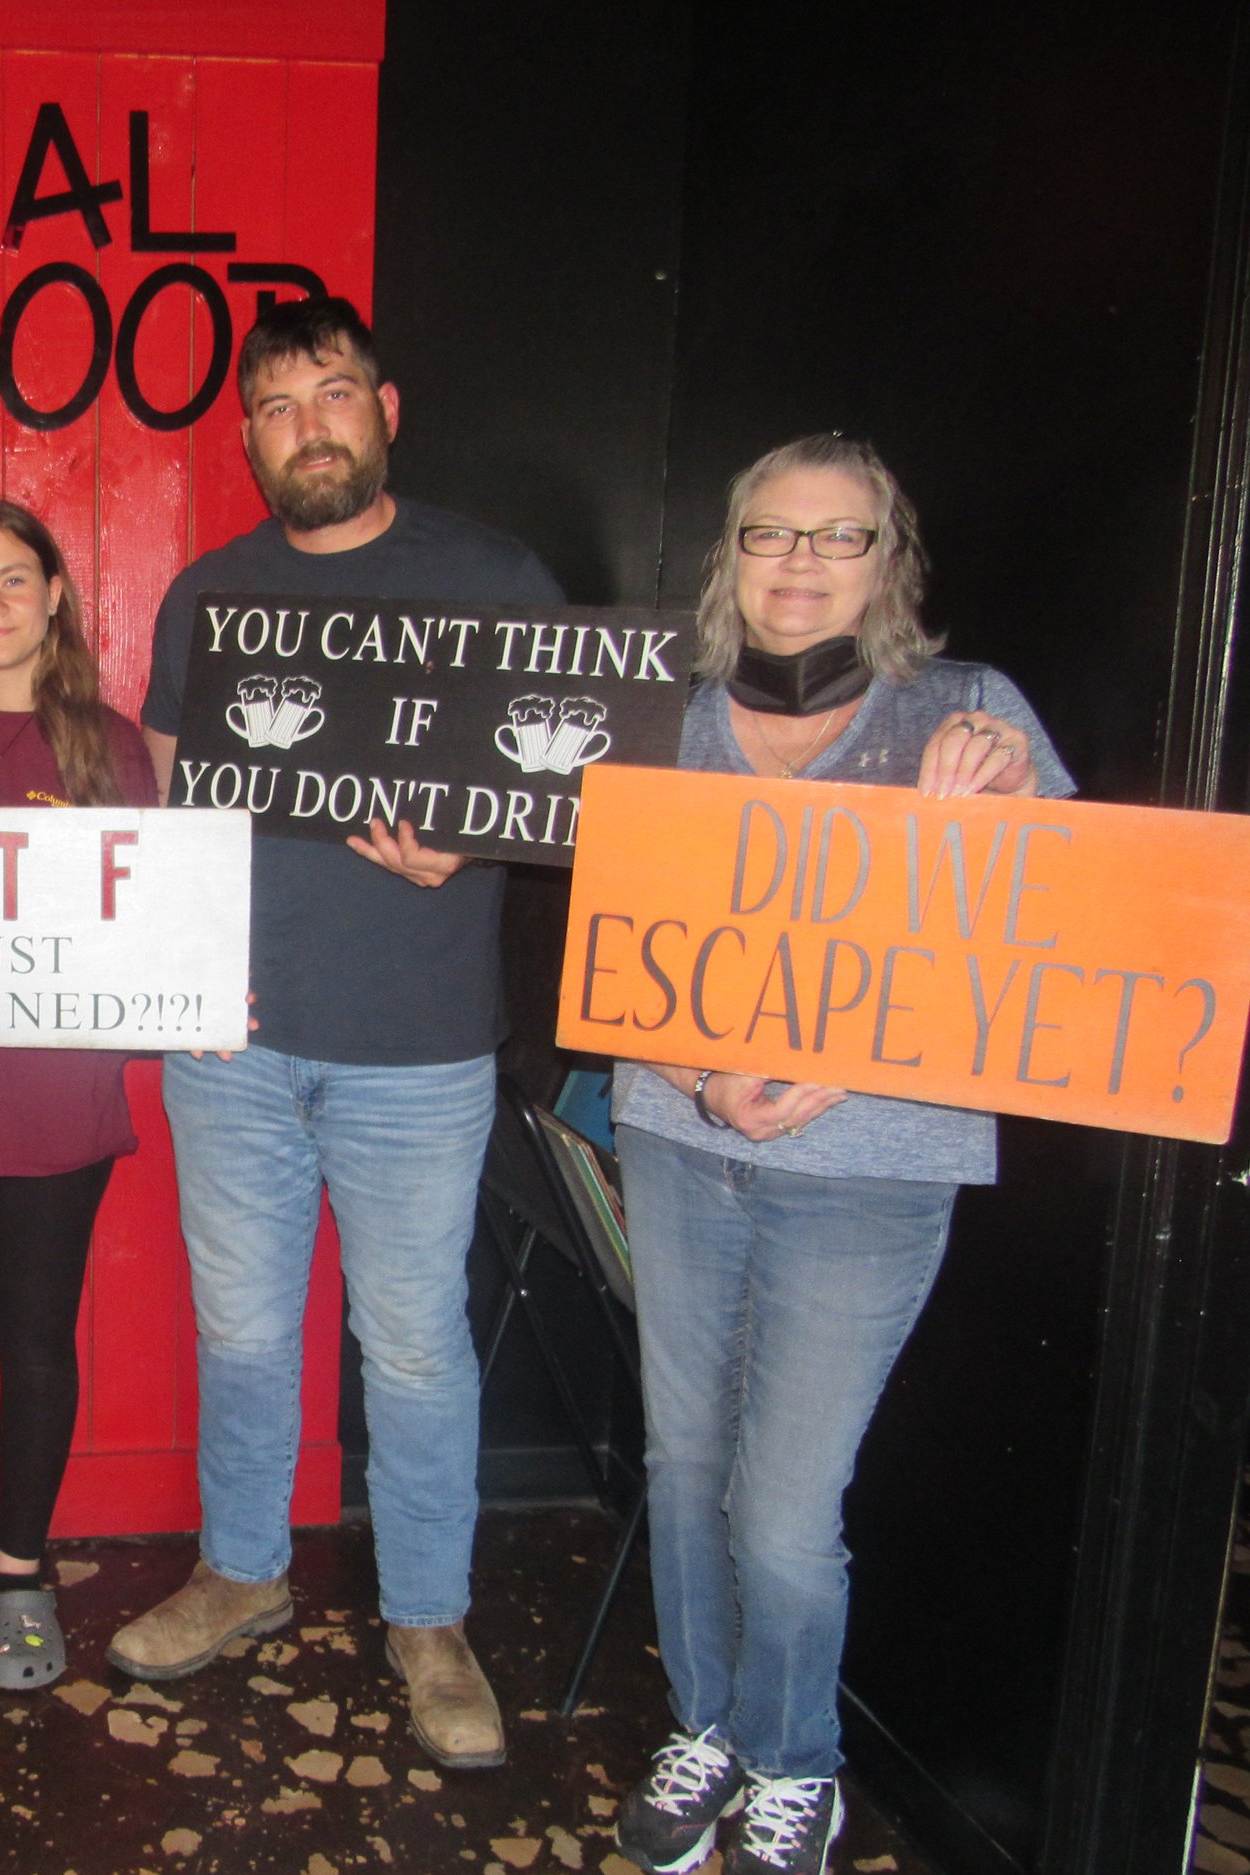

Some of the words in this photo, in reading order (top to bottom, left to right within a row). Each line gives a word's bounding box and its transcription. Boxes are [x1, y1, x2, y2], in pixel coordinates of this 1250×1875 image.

[206, 607, 309, 657] YOU
[320, 612, 479, 668] CAN'T
[494, 621, 677, 682] THINK
[385, 696, 437, 747] IF
[178, 760, 281, 814] YOU
[290, 770, 451, 832] DON'T
[730, 799, 871, 925] DID
[905, 813, 1072, 949] WE
[580, 913, 935, 1068] ESCAPE
[967, 953, 1218, 1104] YET?
